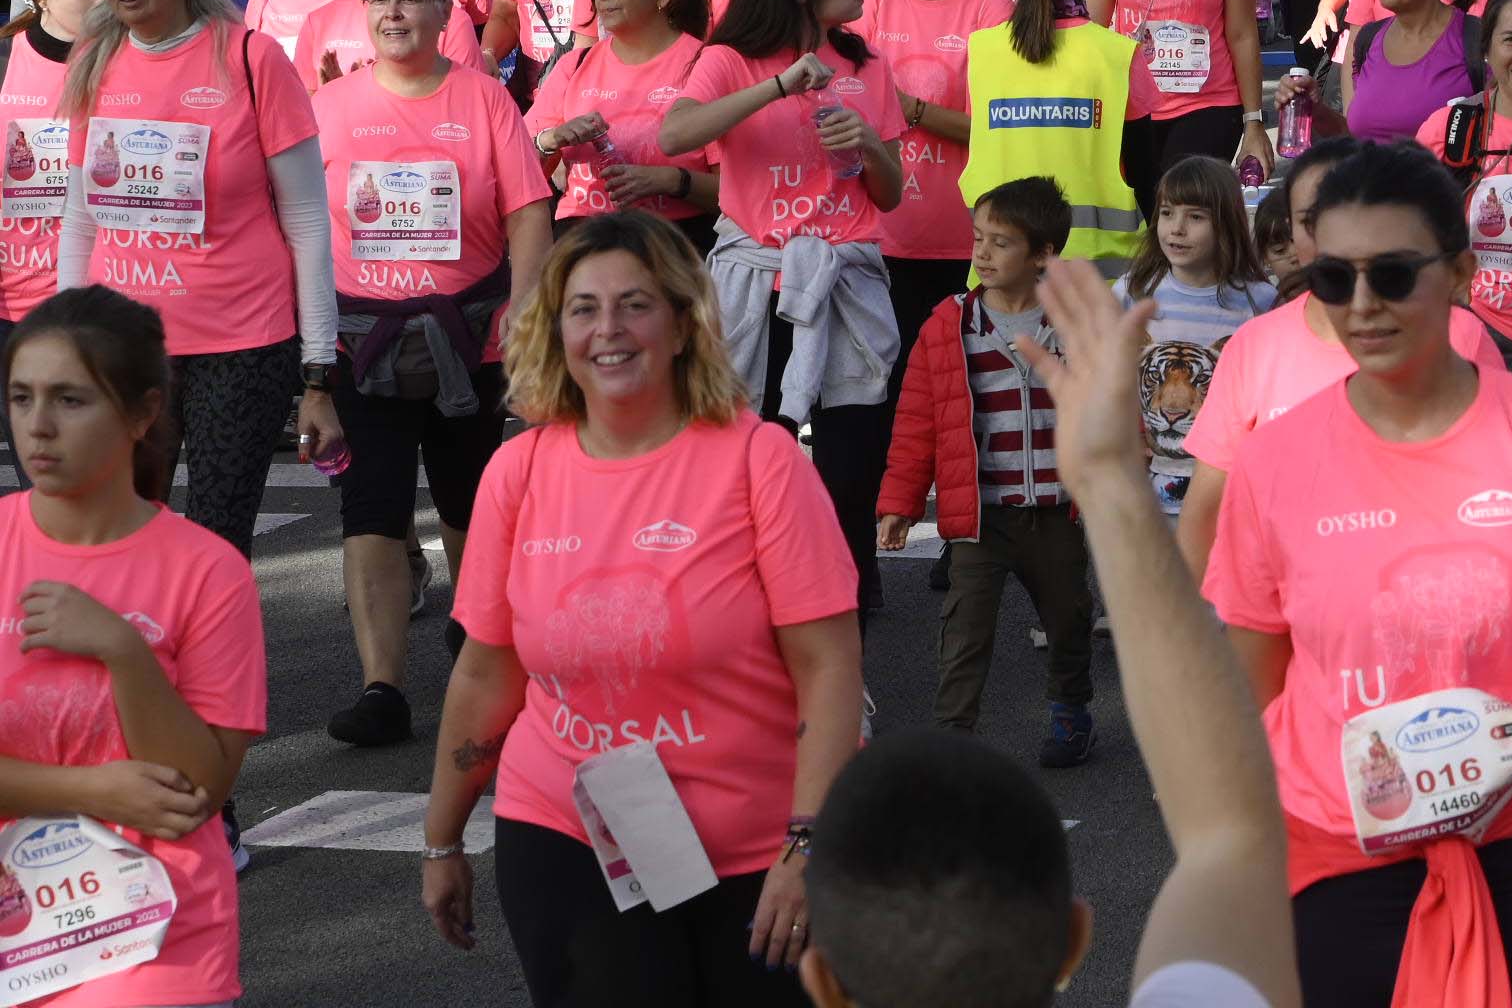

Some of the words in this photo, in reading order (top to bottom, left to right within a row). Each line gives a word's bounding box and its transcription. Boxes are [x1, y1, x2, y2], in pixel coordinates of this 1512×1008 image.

[1157, 48, 1184, 59] 016
[1159, 61, 1181, 69] 22145
[100, 94, 141, 106] OYSHO
[990, 105, 1090, 122] VOLUNTARIS
[352, 125, 397, 139] OYSHO
[34, 135, 70, 146] ASTURIA
[122, 137, 170, 151] ASTURIANA
[124, 164, 164, 181] 016
[430, 173, 452, 181] SUMA
[769, 165, 802, 190] TU
[127, 184, 160, 196] 25242
[382, 176, 425, 189] ASTURIANA
[14, 189, 41, 197] CARRERA
[12, 202, 47, 212] OYSHO
[98, 197, 127, 206] CARRERA
[142, 199, 150, 207] LA
[151, 200, 175, 209] MUJER
[176, 201, 193, 210] 2023
[385, 200, 421, 216] 016
[96, 211, 130, 223] OYSHO
[159, 214, 197, 226] Santander
[391, 218, 415, 229] 6752
[360, 231, 390, 239] CARRERA
[391, 231, 401, 239] DE
[402, 231, 411, 239] LA
[410, 232, 433, 240] MUJER
[358, 245, 391, 254] OYSHO
[104, 256, 184, 287] SUMA
[357, 263, 438, 291] SUMA
[1316, 508, 1397, 537] OYSHO
[522, 535, 583, 558] OYSHO
[1338, 665, 1387, 711] TU
[1401, 719, 1476, 747] ASTURIANA
[1414, 756, 1483, 795] 016
[1429, 790, 1482, 817] 14460
[1384, 825, 1439, 847] CARRERA
[1439, 822, 1456, 835] DE
[1457, 816, 1472, 830] LA
[36, 870, 101, 910] 016
[54, 905, 97, 930] 7296
[6, 940, 60, 964] CARRERA
[61, 935, 77, 948] DE
[78, 930, 93, 943] LA
[95, 917, 133, 938] MUJER
[136, 909, 161, 924] 2023
[8, 962, 69, 993] OYSHO
